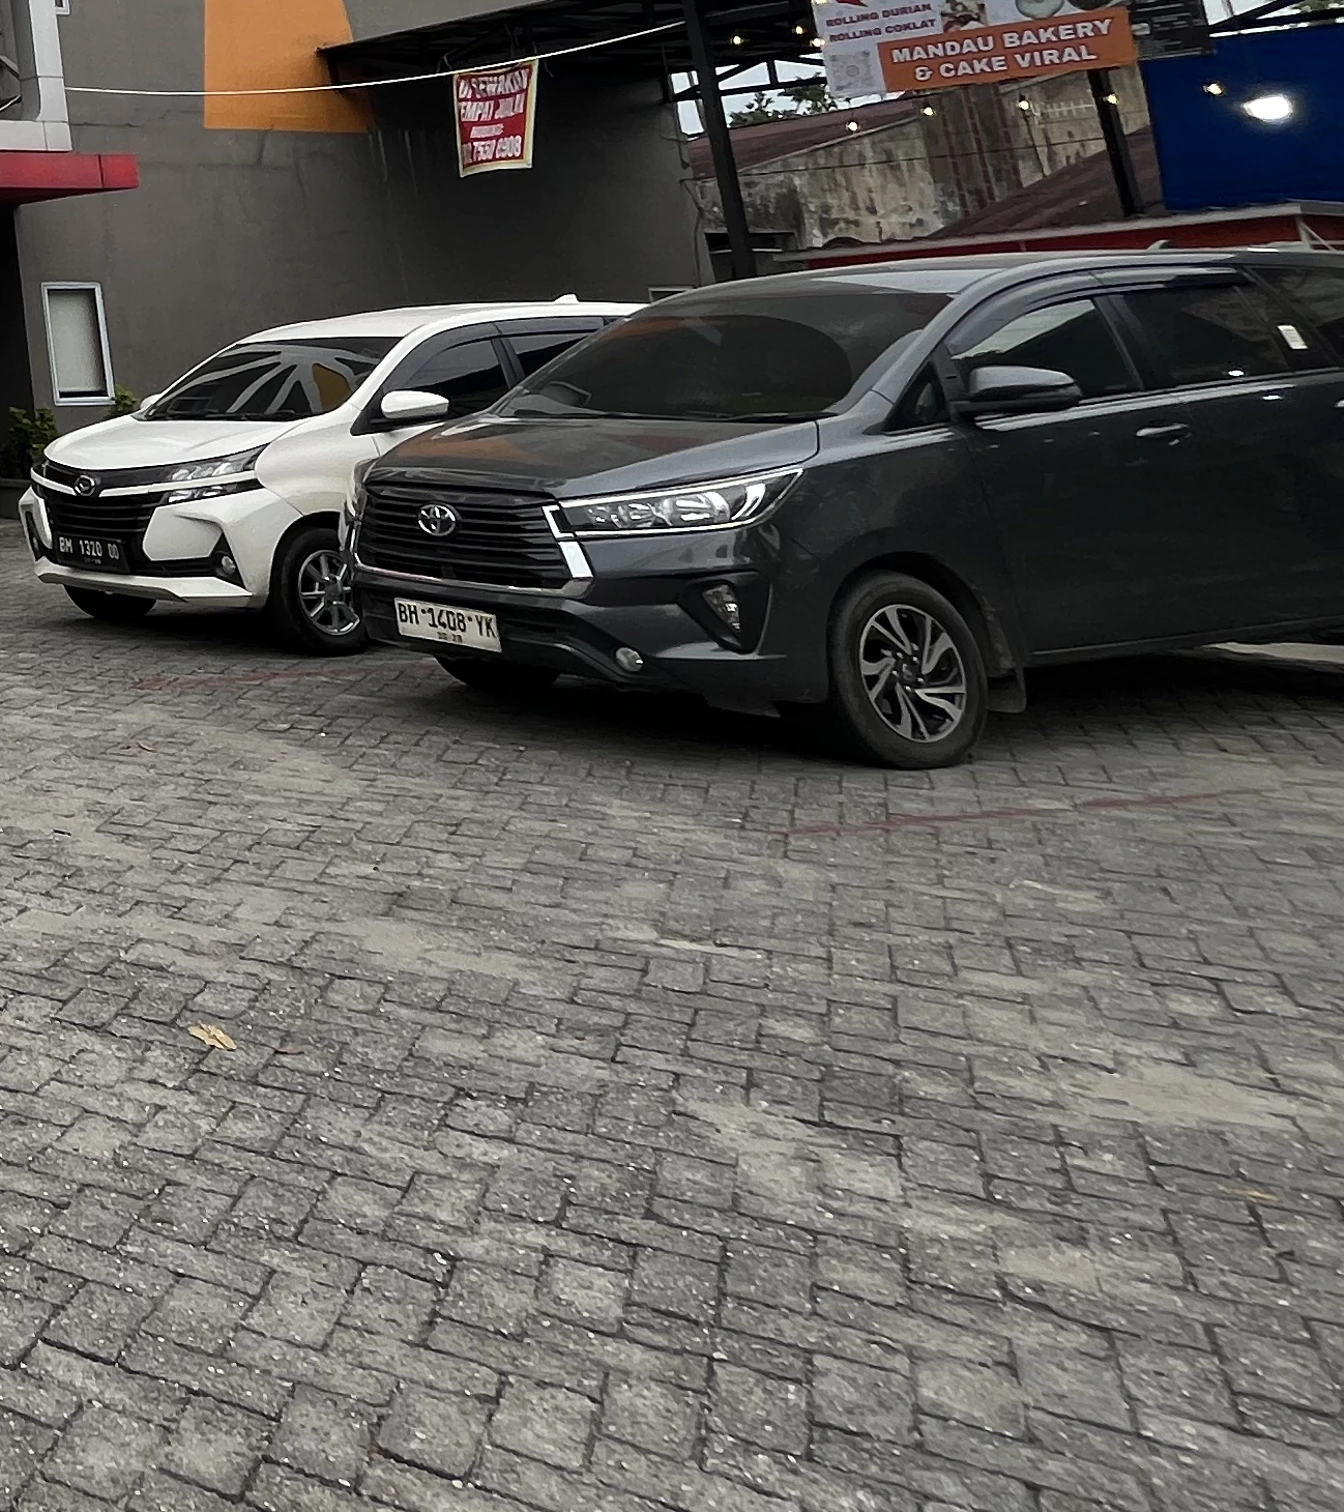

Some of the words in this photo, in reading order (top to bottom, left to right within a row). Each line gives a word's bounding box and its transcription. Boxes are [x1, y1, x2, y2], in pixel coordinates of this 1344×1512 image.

[825, 12, 880, 27] ROLLING
[882, 3, 932, 18] DURIAN
[828, 28, 883, 42] ROLLING
[885, 19, 937, 34] COKLAT
[891, 35, 994, 64] MANDAU
[1003, 18, 1114, 49] BAKERY
[914, 65, 934, 81] &
[939, 55, 1007, 77] CAKE
[1013, 44, 1098, 69] VIRAL
[426, 607, 467, 633] 1408
[474, 615, 497, 639] YK
